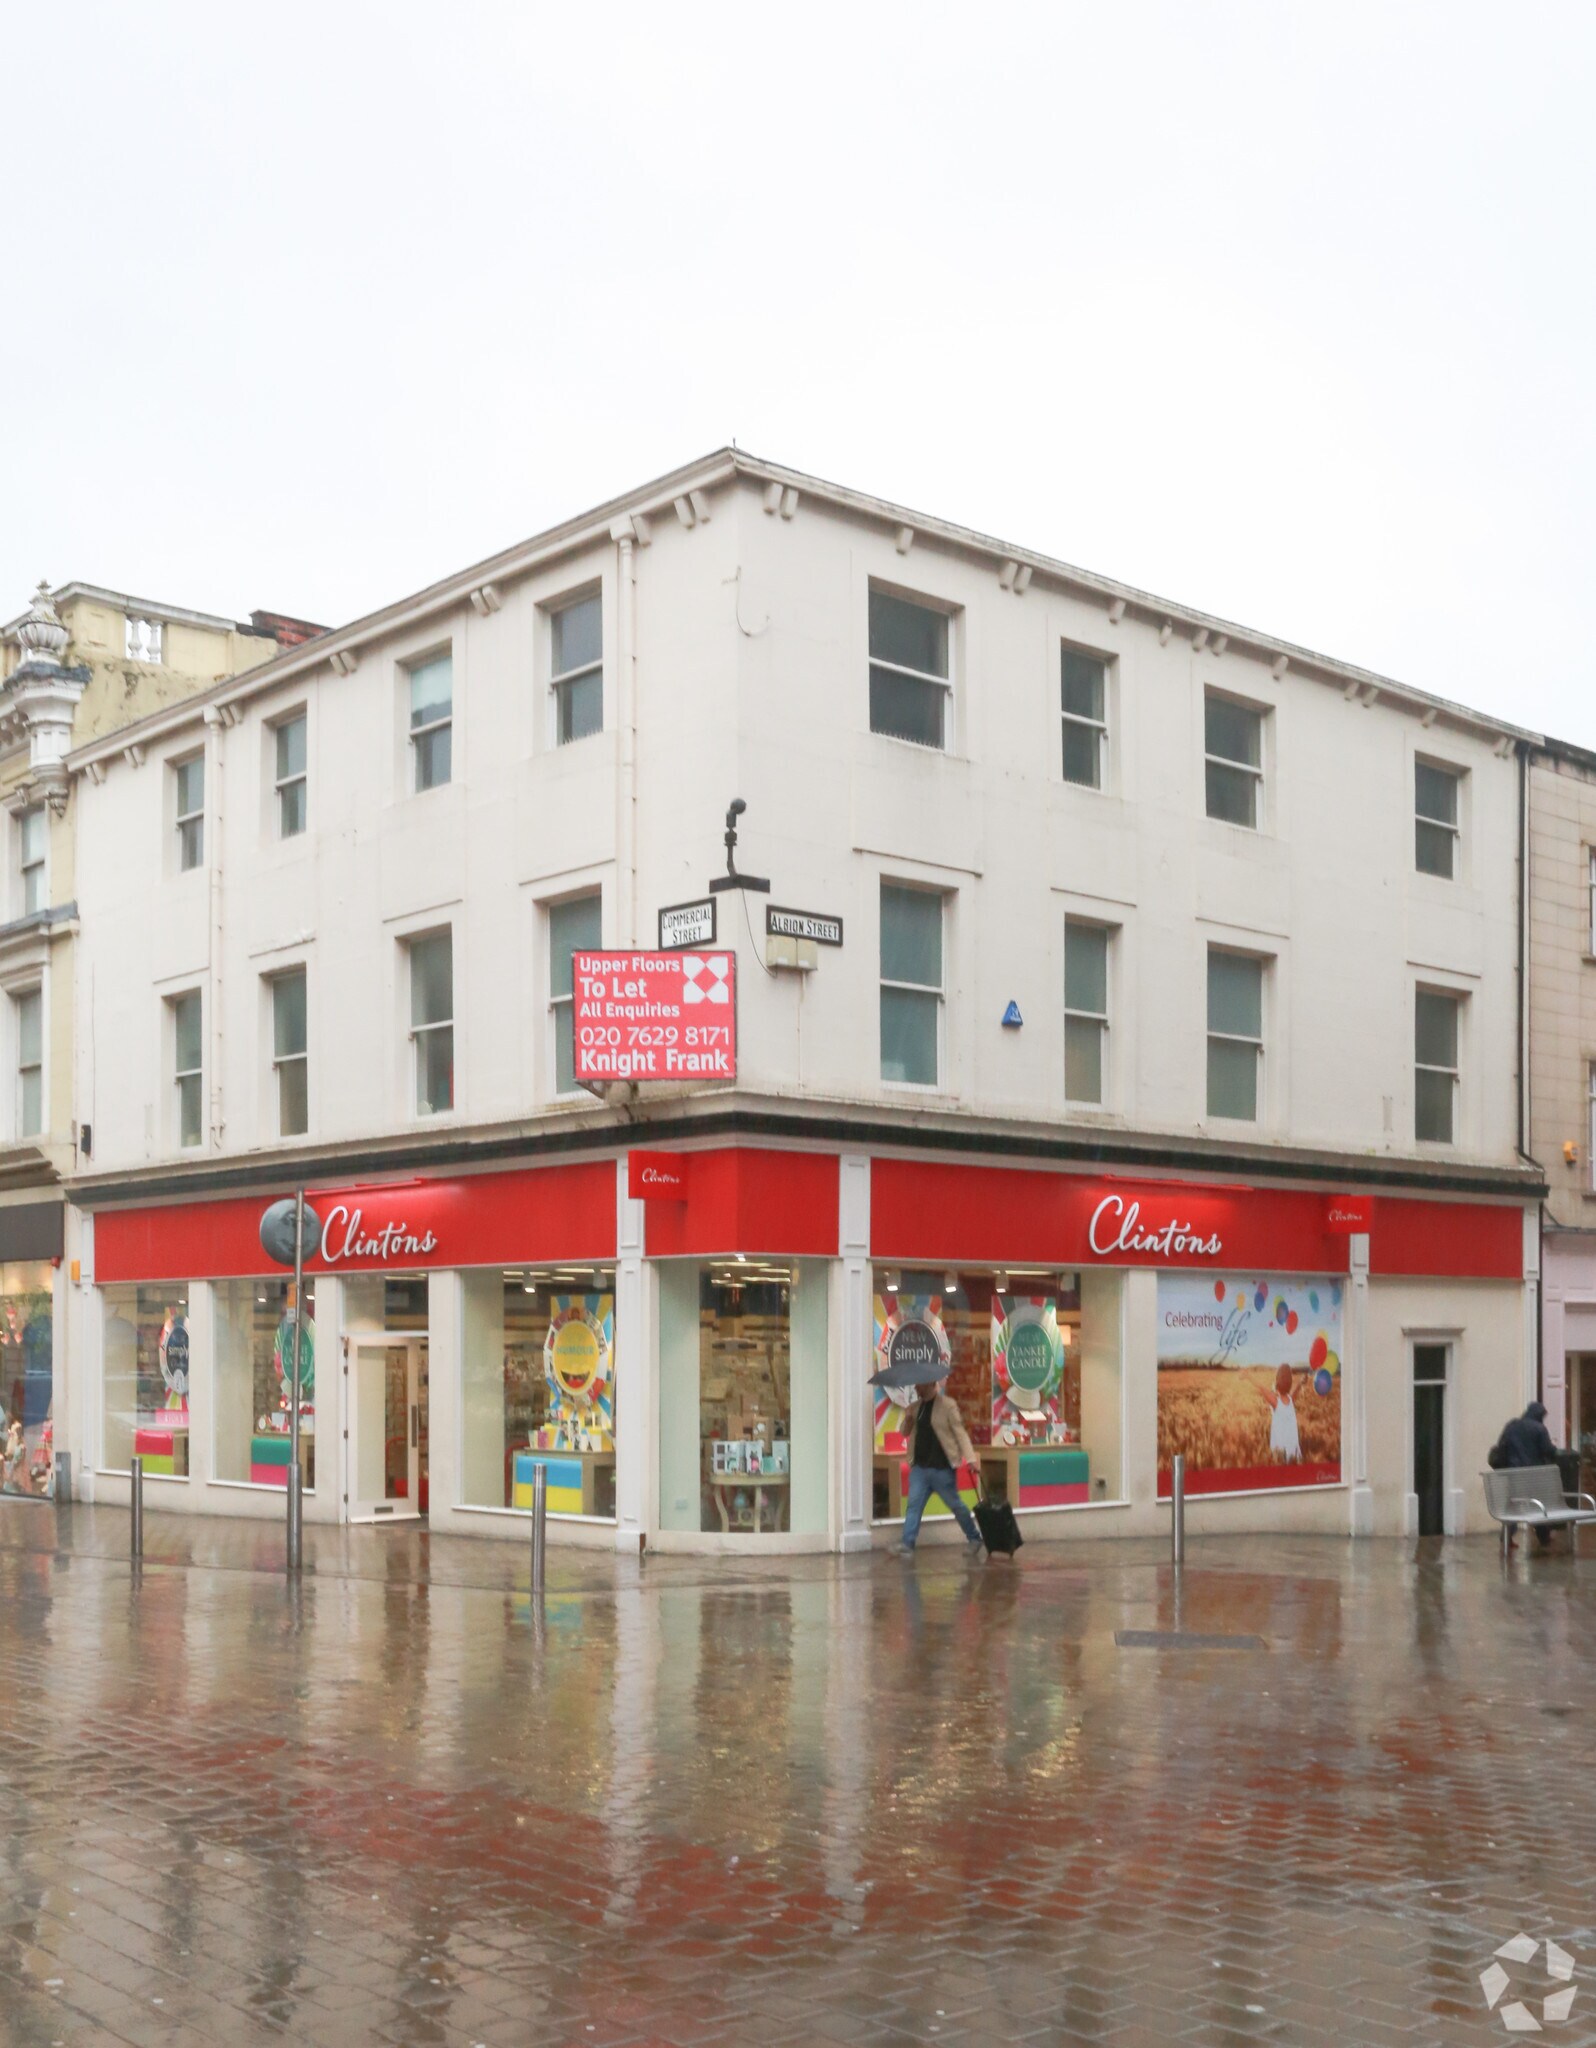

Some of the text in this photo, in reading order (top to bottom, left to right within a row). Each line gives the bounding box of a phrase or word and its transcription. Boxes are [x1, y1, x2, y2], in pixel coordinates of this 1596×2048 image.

[662, 905, 711, 930] COMMERCIAL
[771, 913, 840, 939] ALBION STREET
[672, 926, 702, 944] STREET
[579, 957, 680, 975] Upper Floors
[579, 977, 647, 998] To Let
[579, 1001, 680, 1021] All Enquiries
[580, 1026, 730, 1046] 020 7629 8171
[580, 1048, 730, 1078] Knight Frank
[321, 1205, 438, 1263] Clintons
[1089, 1195, 1223, 1257] Clintons
[1165, 1310, 1224, 1332] Celebrating
[902, 1330, 928, 1343] NEW
[1209, 1307, 1252, 1364] life
[895, 1344, 934, 1364] simply
[1011, 1345, 1047, 1358] YANKEE
[1011, 1357, 1047, 1369] CANDLE
